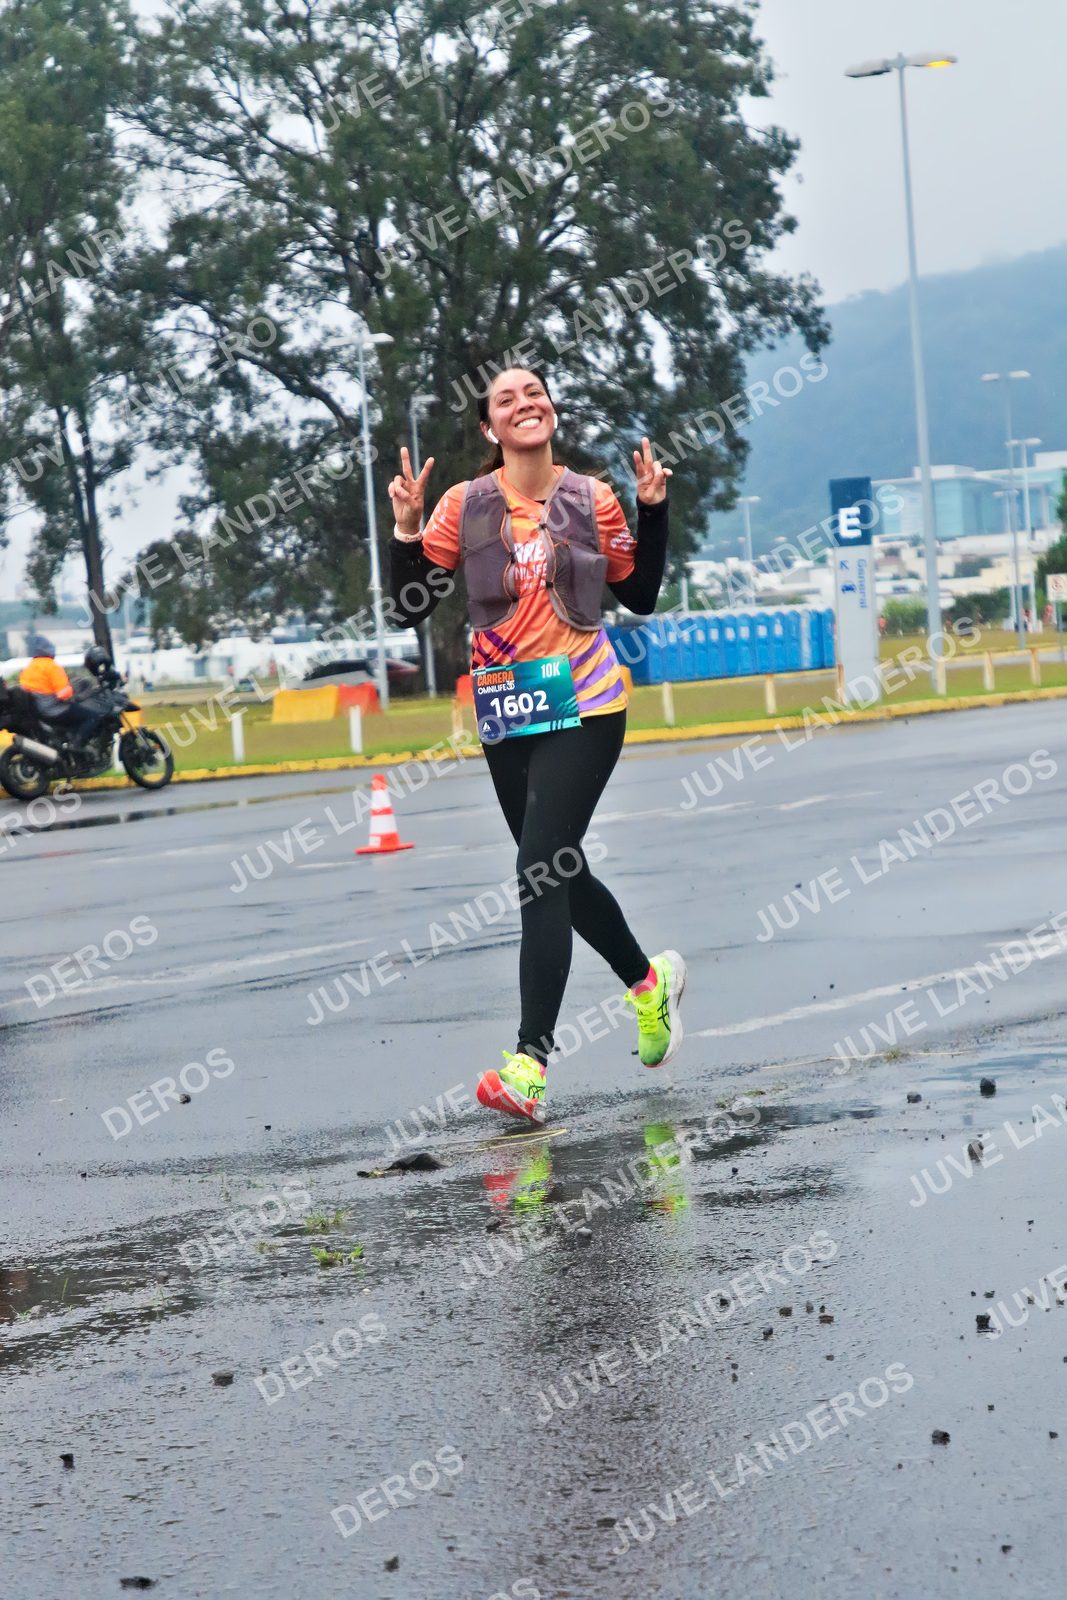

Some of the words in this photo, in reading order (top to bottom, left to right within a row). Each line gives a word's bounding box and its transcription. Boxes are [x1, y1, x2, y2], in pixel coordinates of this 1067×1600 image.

[838, 507, 862, 539] E
[477, 670, 515, 687] CARRERA
[540, 662, 560, 679] 10K
[489, 690, 549, 718] 1602
